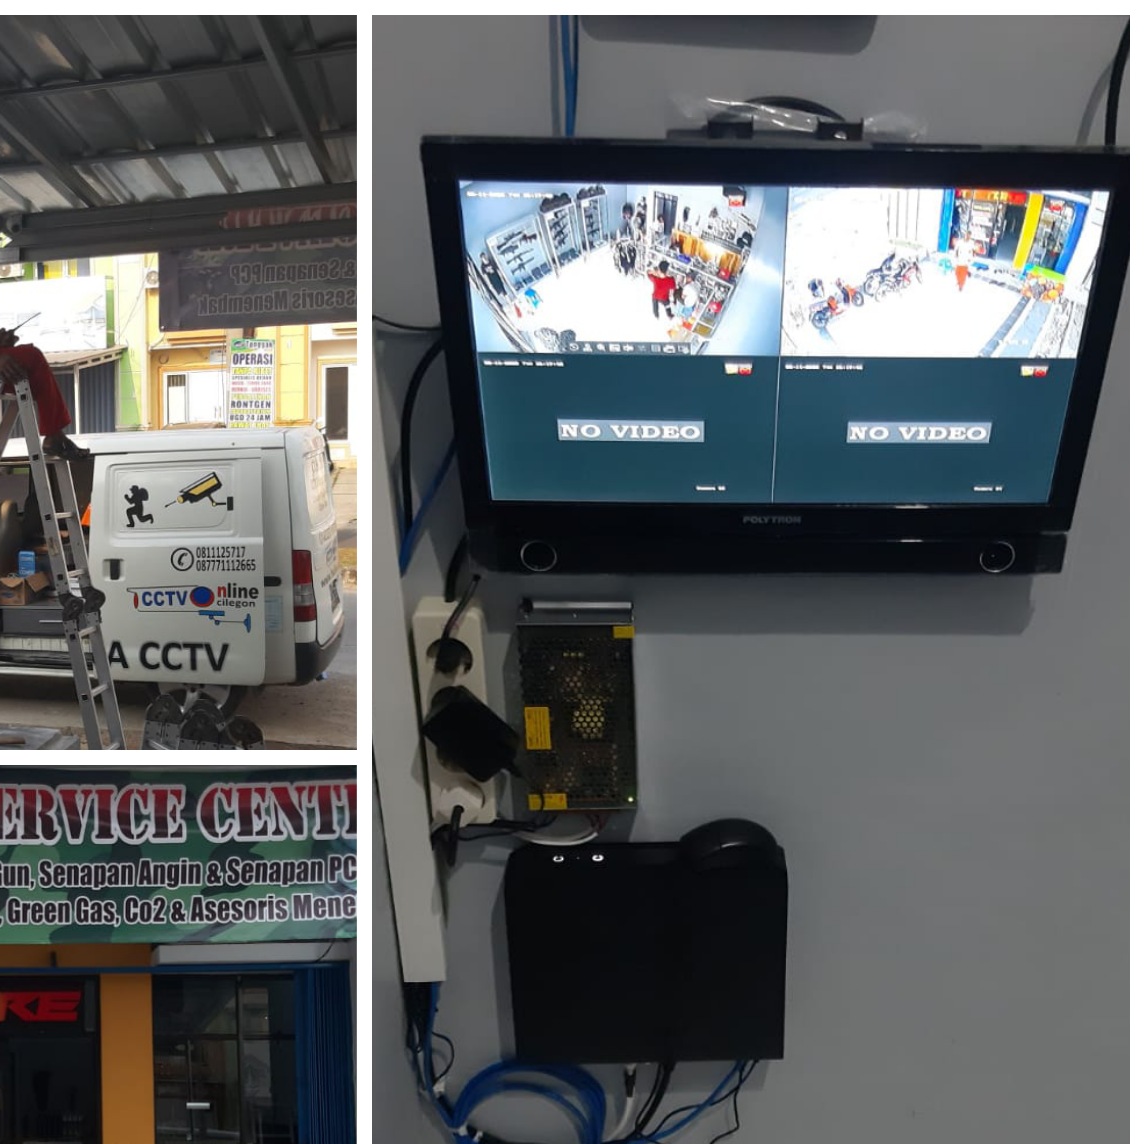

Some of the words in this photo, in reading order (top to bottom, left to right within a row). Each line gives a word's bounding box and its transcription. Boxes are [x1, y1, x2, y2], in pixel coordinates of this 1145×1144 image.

[233, 353, 273, 365] OPERASI
[231, 400, 271, 409] RONTGEN
[560, 422, 602, 440] NO
[610, 422, 702, 440] VIDEO
[850, 424, 890, 441] NO
[898, 424, 988, 441] VIDEO
[743, 516, 801, 524] POLYTRON
[196, 547, 246, 559] 0811125717
[196, 559, 256, 572] 087771112665
[141, 591, 188, 607] CCTV
[217, 599, 256, 609] cilegon
[139, 641, 230, 672] CCTV
[38, 859, 135, 889] Senapan
[137, 858, 203, 889] Angin
[207, 861, 224, 886] &
[226, 856, 325, 887] Senapan
[6, 897, 71, 925] Green
[74, 897, 120, 927] Gas,
[124, 896, 168, 924] Co2
[170, 898, 186, 924] &
[189, 894, 288, 923] Asesoris
